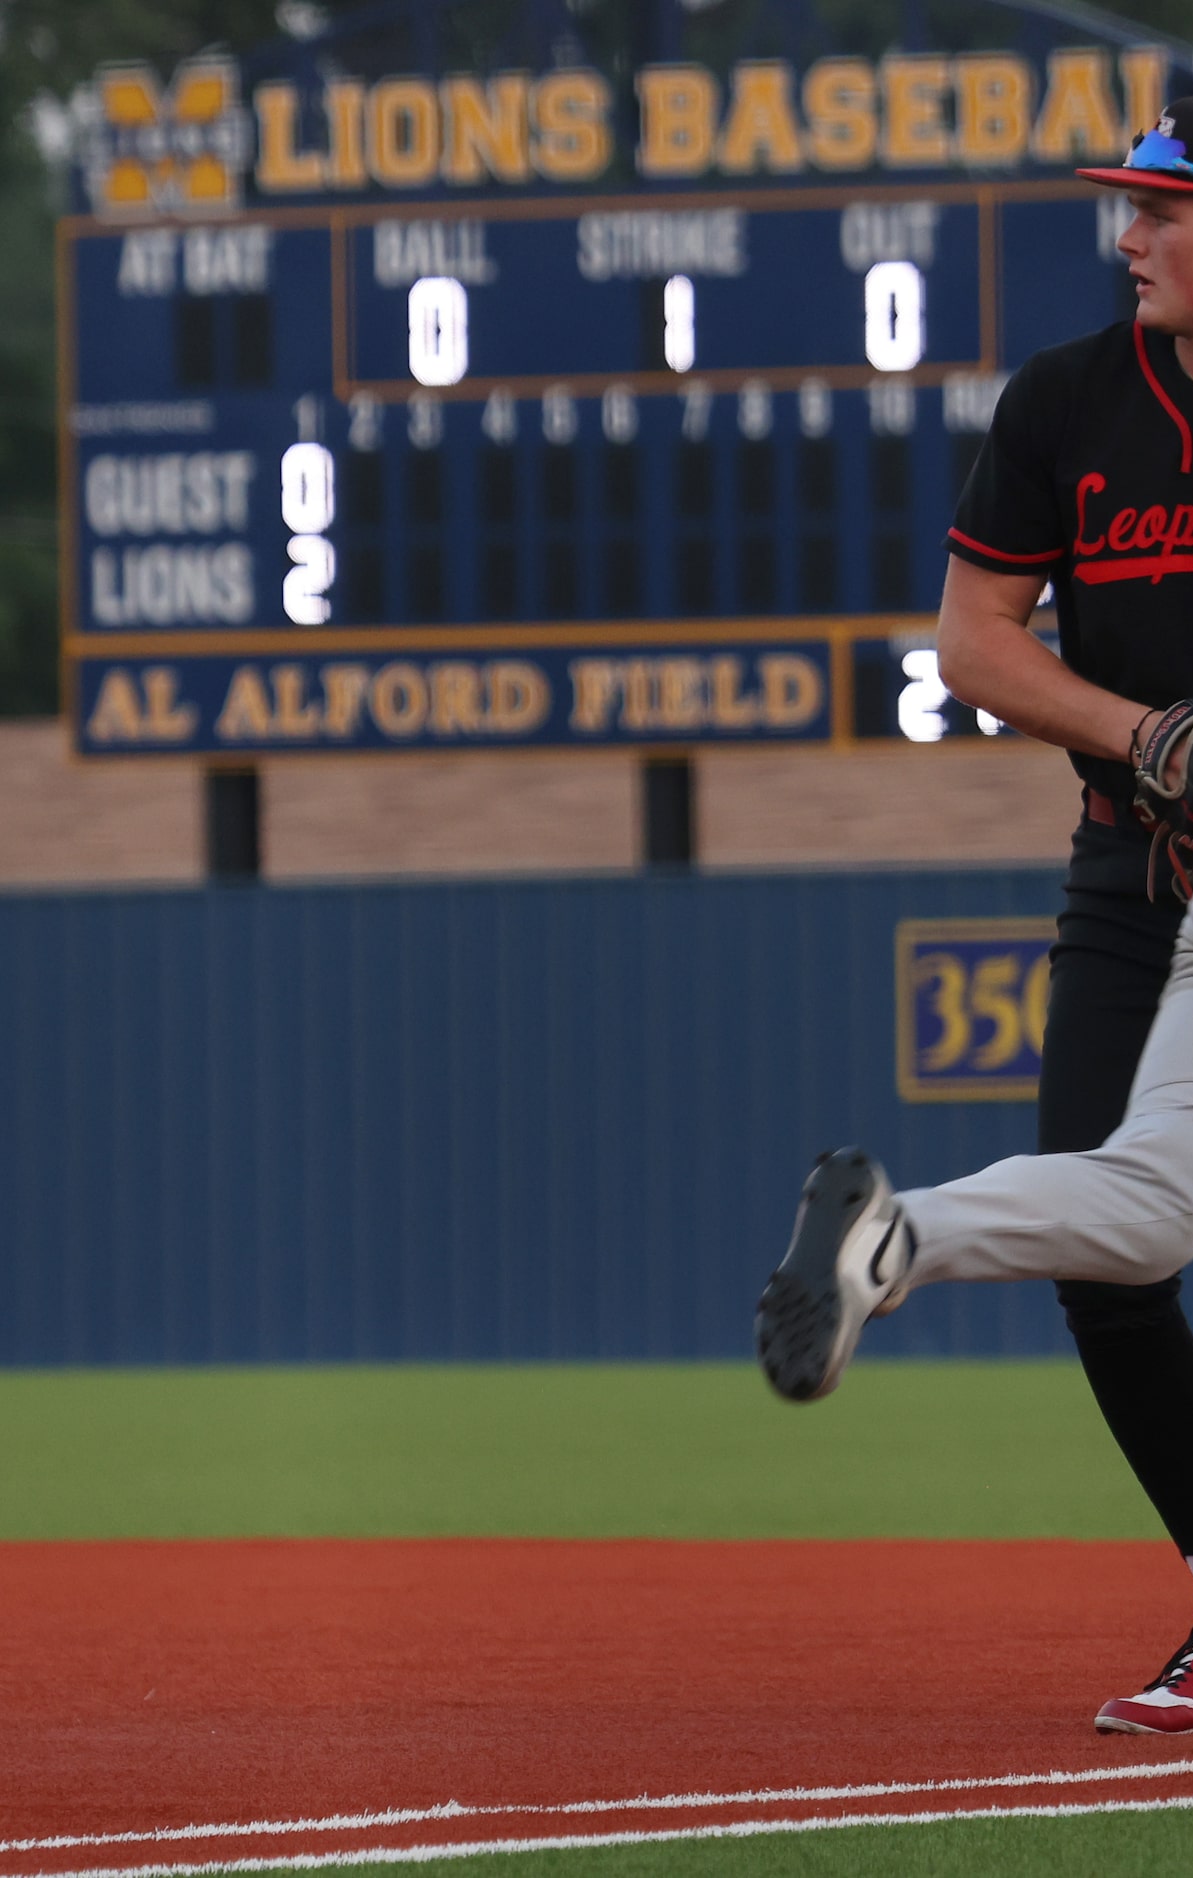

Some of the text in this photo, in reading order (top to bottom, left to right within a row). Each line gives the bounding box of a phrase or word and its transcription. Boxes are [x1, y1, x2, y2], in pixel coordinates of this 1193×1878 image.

[253, 68, 612, 191] LIONS
[118, 222, 274, 296] AT BAT
[373, 213, 495, 288] BALL
[576, 206, 750, 284] STRIKE
[840, 198, 942, 272] OUT
[408, 277, 468, 386] 0
[663, 273, 696, 373] 1
[864, 260, 924, 372] 0
[85, 450, 255, 537] GUEST
[281, 442, 334, 535] 0
[90, 539, 255, 627] LIONS
[282, 534, 335, 625] 2
[89, 650, 824, 745] AL ALFORD FIELD
